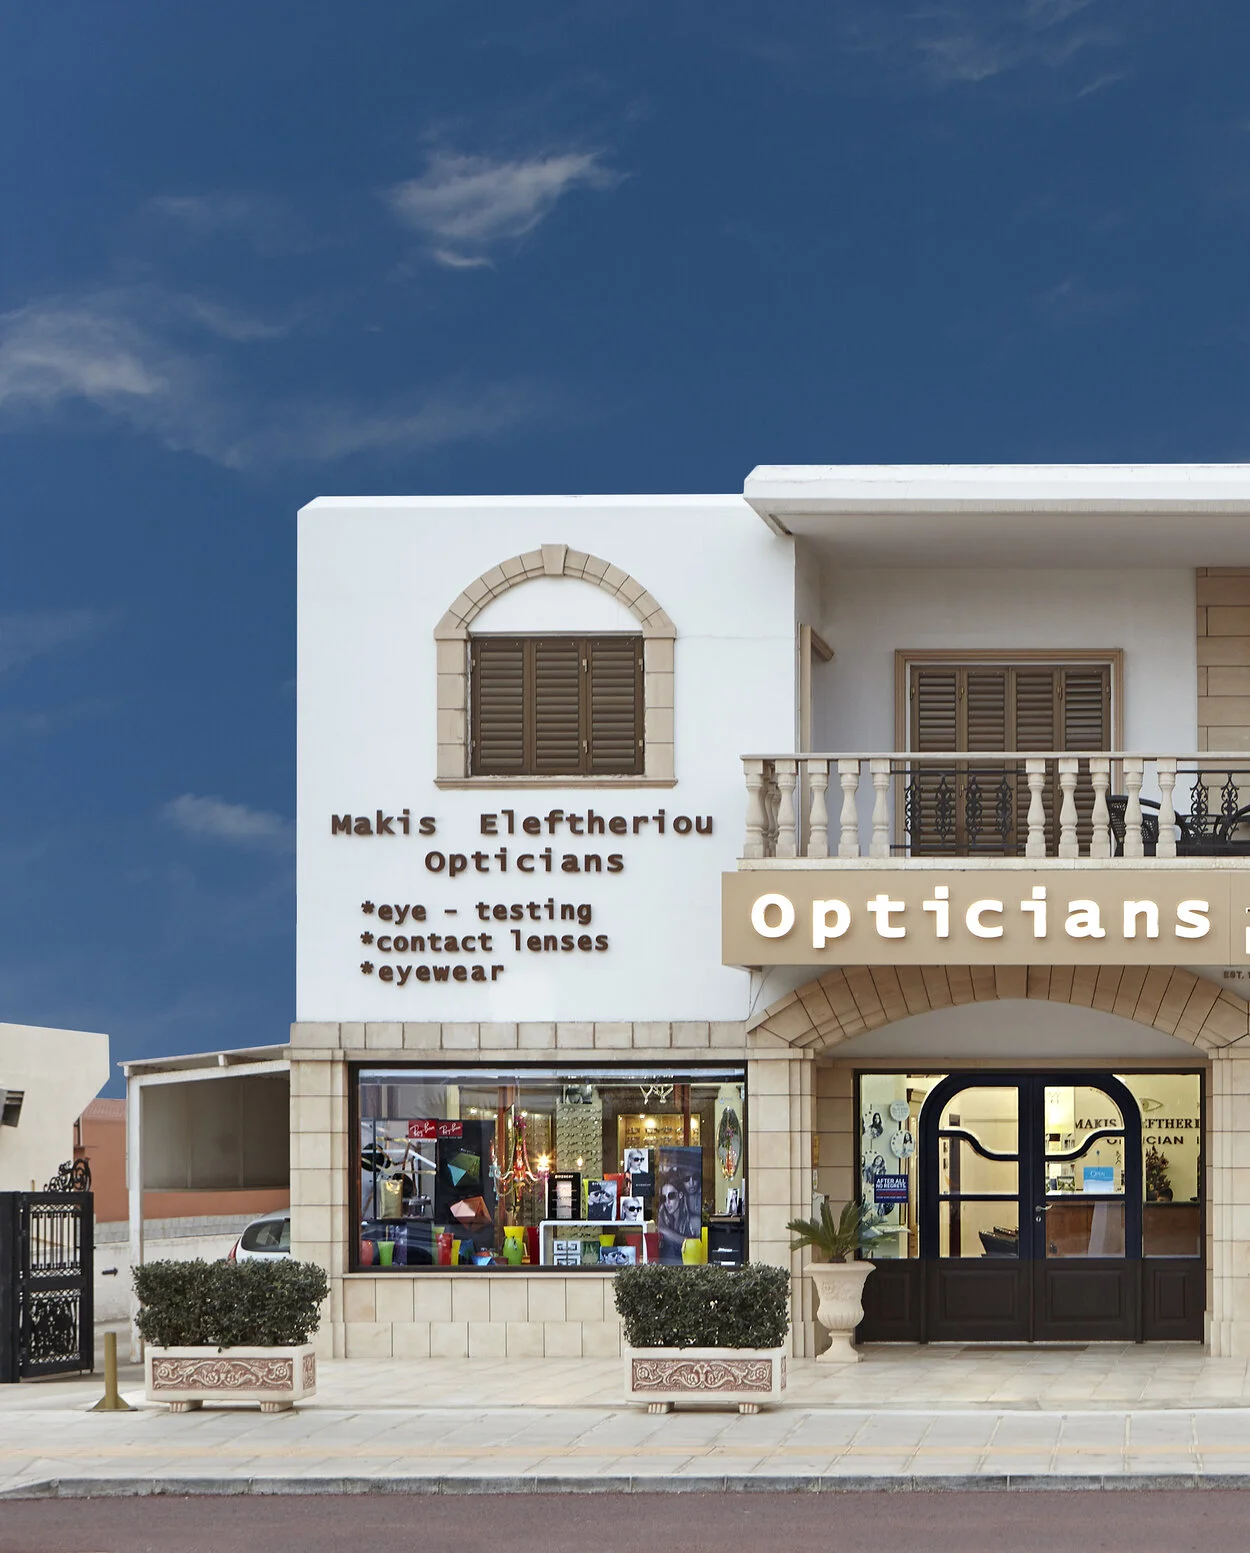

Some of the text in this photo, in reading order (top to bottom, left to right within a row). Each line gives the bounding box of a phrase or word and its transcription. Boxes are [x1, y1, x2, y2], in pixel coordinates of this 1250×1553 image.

[331, 808, 714, 836] Makis Eleftheriou
[424, 846, 625, 877] Opticians
[474, 897, 593, 925] testing
[751, 885, 1210, 949] Opticians
[510, 928, 609, 953] lenses
[1075, 1118, 1117, 1129] MAKIS
